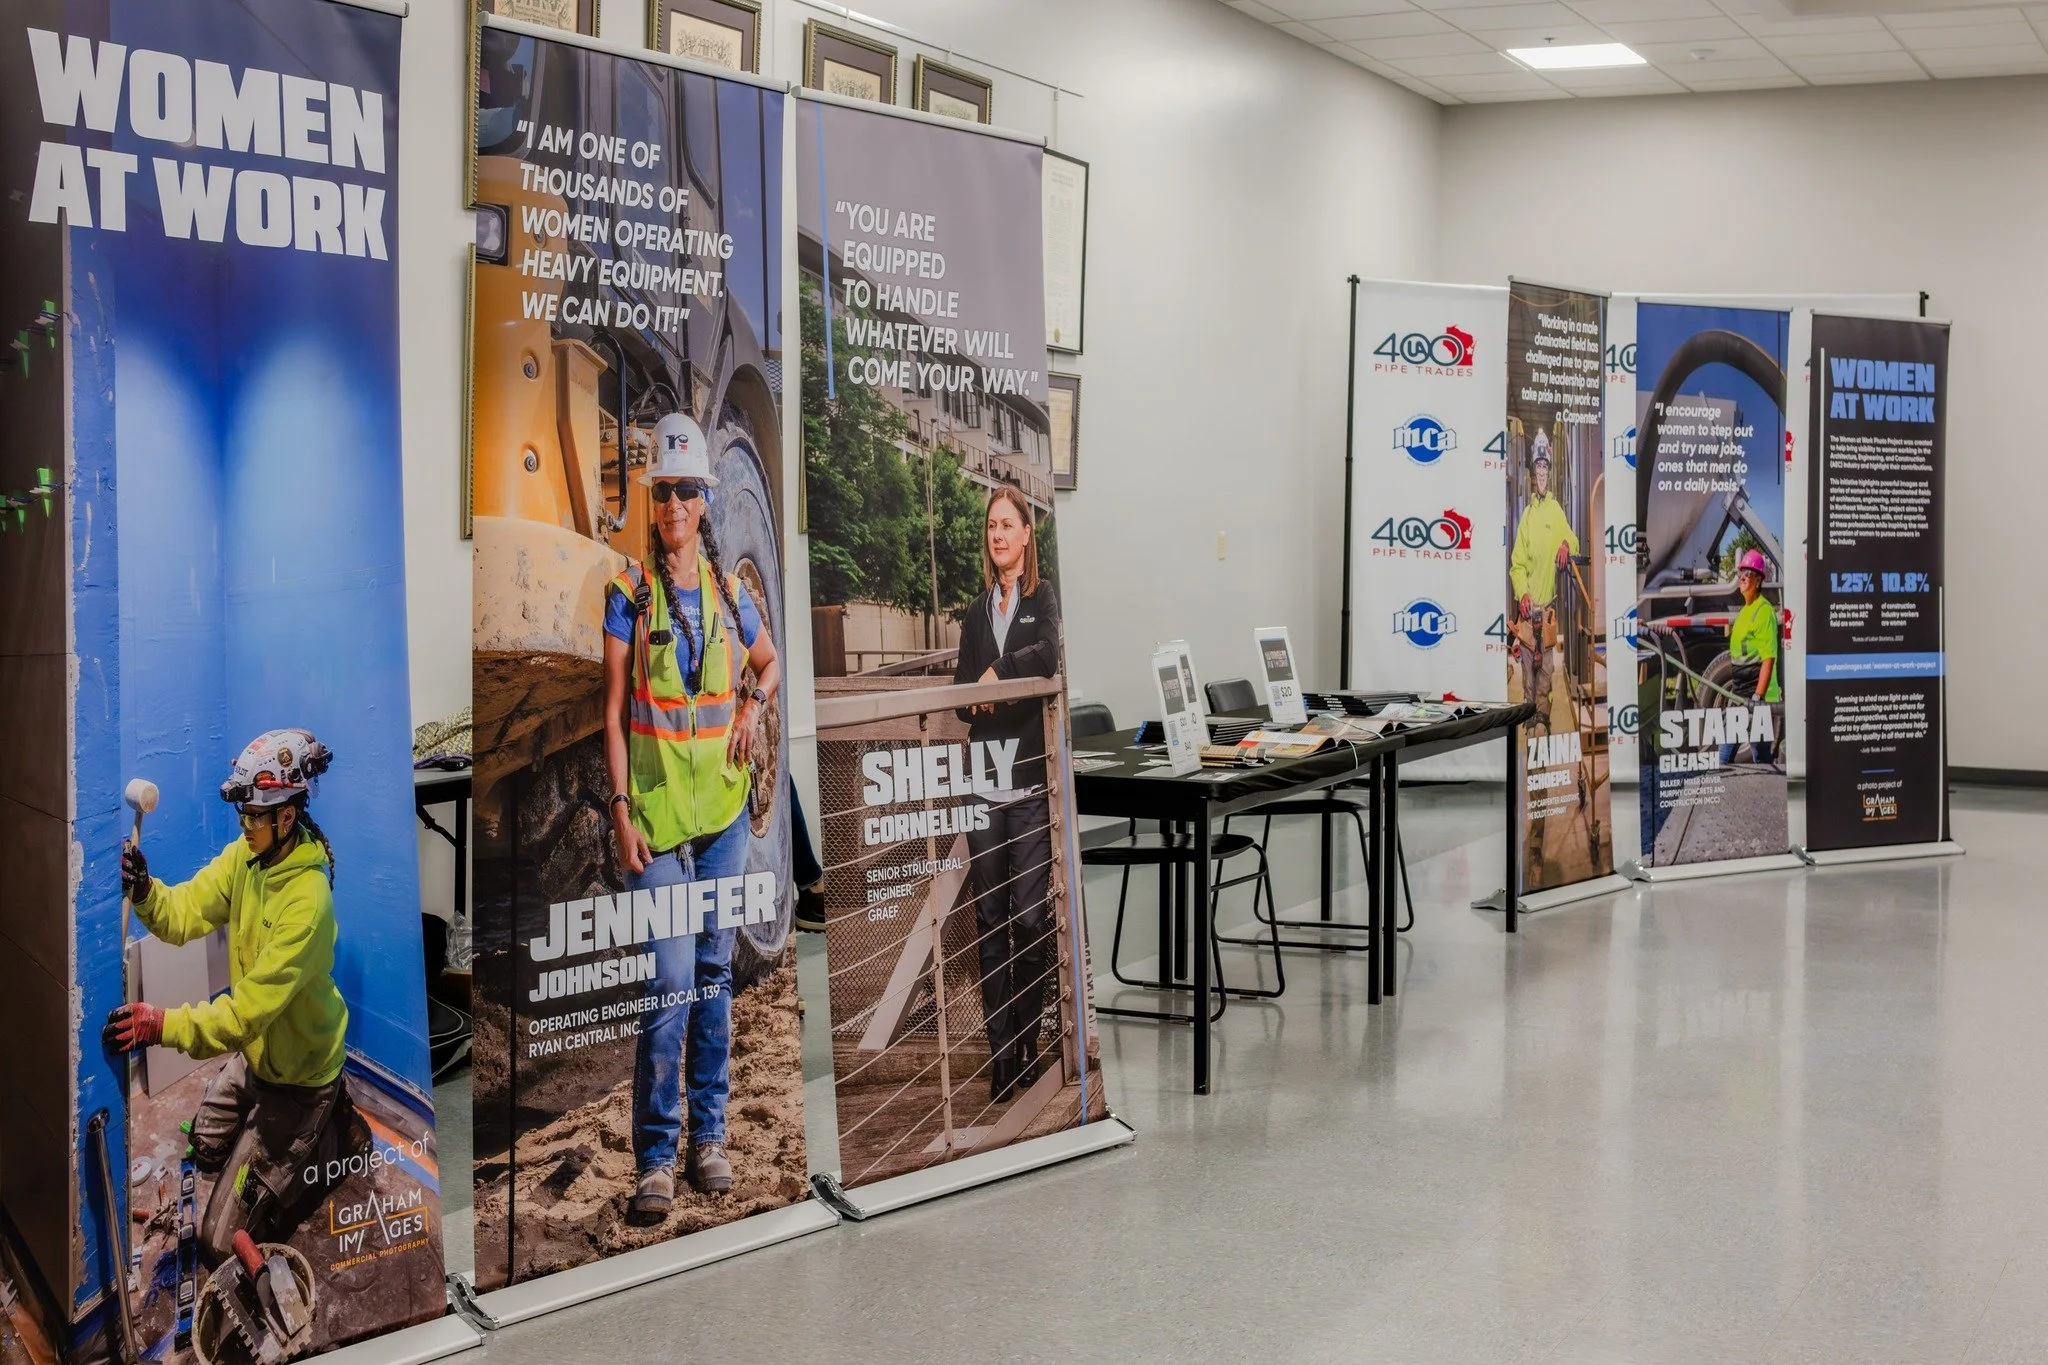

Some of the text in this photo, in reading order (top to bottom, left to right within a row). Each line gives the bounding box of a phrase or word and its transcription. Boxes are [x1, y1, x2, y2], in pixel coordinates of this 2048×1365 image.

[27, 27, 387, 175] WOMEN
[538, 125, 573, 156] AM
[579, 132, 626, 164] ONE
[631, 141, 661, 169] OF
[28, 140, 389, 261] AT WORK
[520, 163, 689, 214] THOUSANDS OF
[522, 206, 734, 259] WOMEN OPERATING
[894, 211, 936, 242] ARE
[522, 249, 723, 298] HEAVY EQUIPMENT.
[843, 240, 945, 279] EQUIPPED
[522, 291, 558, 322] WE
[563, 296, 610, 327] CAN
[615, 302, 650, 330] DO
[842, 278, 959, 318] TO HANDLE
[846, 318, 1014, 358] WHATEVER WILL
[1535, 332, 1598, 353] dominated field has
[1569, 318, 1575, 331] in
[1576, 322, 1581, 332] a
[1582, 321, 1598, 335] male
[850, 356, 910, 388] COME
[917, 362, 975, 393] YOUR
[1375, 364, 1473, 377] PIPE TRADES
[1526, 349, 1600, 372] challenged me to grow
[1830, 357, 1935, 393] WOMEN
[1532, 368, 1599, 390] in my leadership and
[1522, 387, 1599, 407] take pride in my work as
[1666, 406, 1721, 420] encourage
[1830, 392, 1935, 423] AT WORK
[1556, 411, 1561, 421] a
[1657, 424, 1753, 439] women to step out
[1658, 441, 1745, 458] and try new jobs,
[1658, 459, 1747, 473] ones that men do
[1658, 480, 1672, 491] on
[1674, 480, 1681, 491] a
[1684, 478, 1710, 494] daily
[1373, 548, 1471, 560] PIPE TRADES
[1830, 572, 1929, 593] 1.25% 10.8%
[1660, 705, 1774, 748] STARA
[1527, 731, 1582, 770] ZAINA
[1660, 751, 1719, 773] GLEASH
[862, 738, 1020, 806] SHELLY
[1862, 782, 1878, 790] photo
[1878, 781, 1896, 789] project
[1660, 790, 1682, 798] MURPHY
[1684, 786, 1712, 795] CONCRETE
[1660, 798, 1702, 808] CONSTRUCTION
[864, 804, 990, 845] CORNELIUS
[867, 857, 964, 883] SENIOR STRUCTURAL
[868, 884, 914, 903] ENGINEER,
[530, 872, 777, 962] JENNIFER
[869, 905, 899, 922] GRAEF
[529, 952, 656, 1002] JOHNSON
[529, 984, 720, 1036] OPERATING ENGINEER LOCAL 139
[529, 1021, 643, 1058] RYAN CENTRAL INC.
[303, 1131, 429, 1186] a project of
[339, 1188, 422, 1225] GRAHAM
[330, 1237, 429, 1271] COMMERCIAL PHOTOGRAPHY
